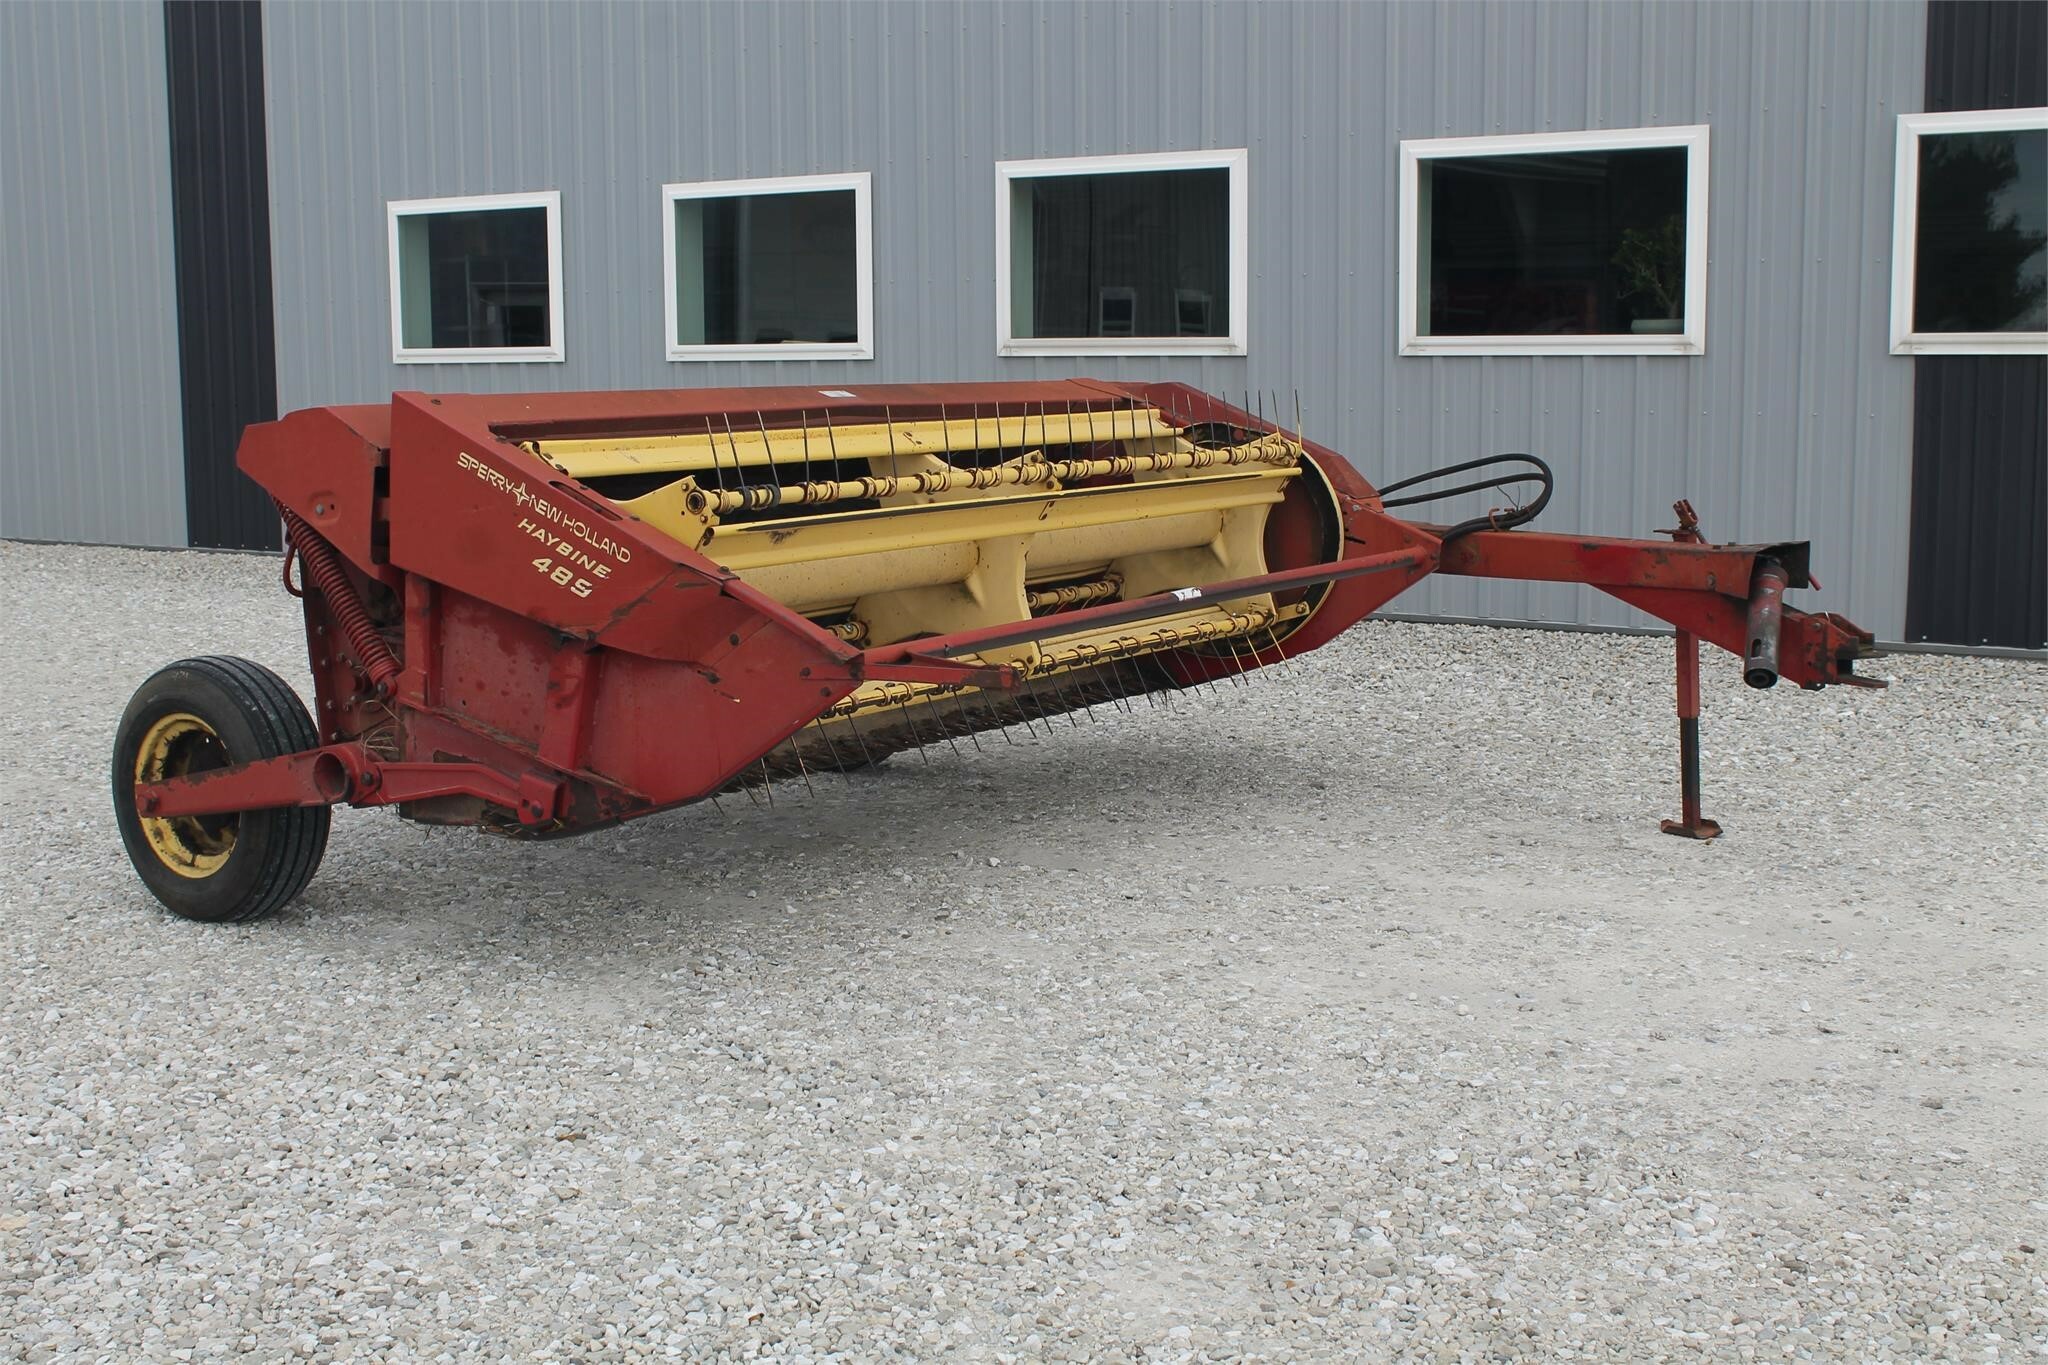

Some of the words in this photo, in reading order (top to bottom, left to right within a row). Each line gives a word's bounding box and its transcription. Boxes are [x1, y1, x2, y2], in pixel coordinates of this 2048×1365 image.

[457, 452, 515, 494] SPERRY
[528, 494, 562, 523] NEW
[562, 513, 631, 563] HOLLAND
[517, 518, 612, 579] HAYBINE
